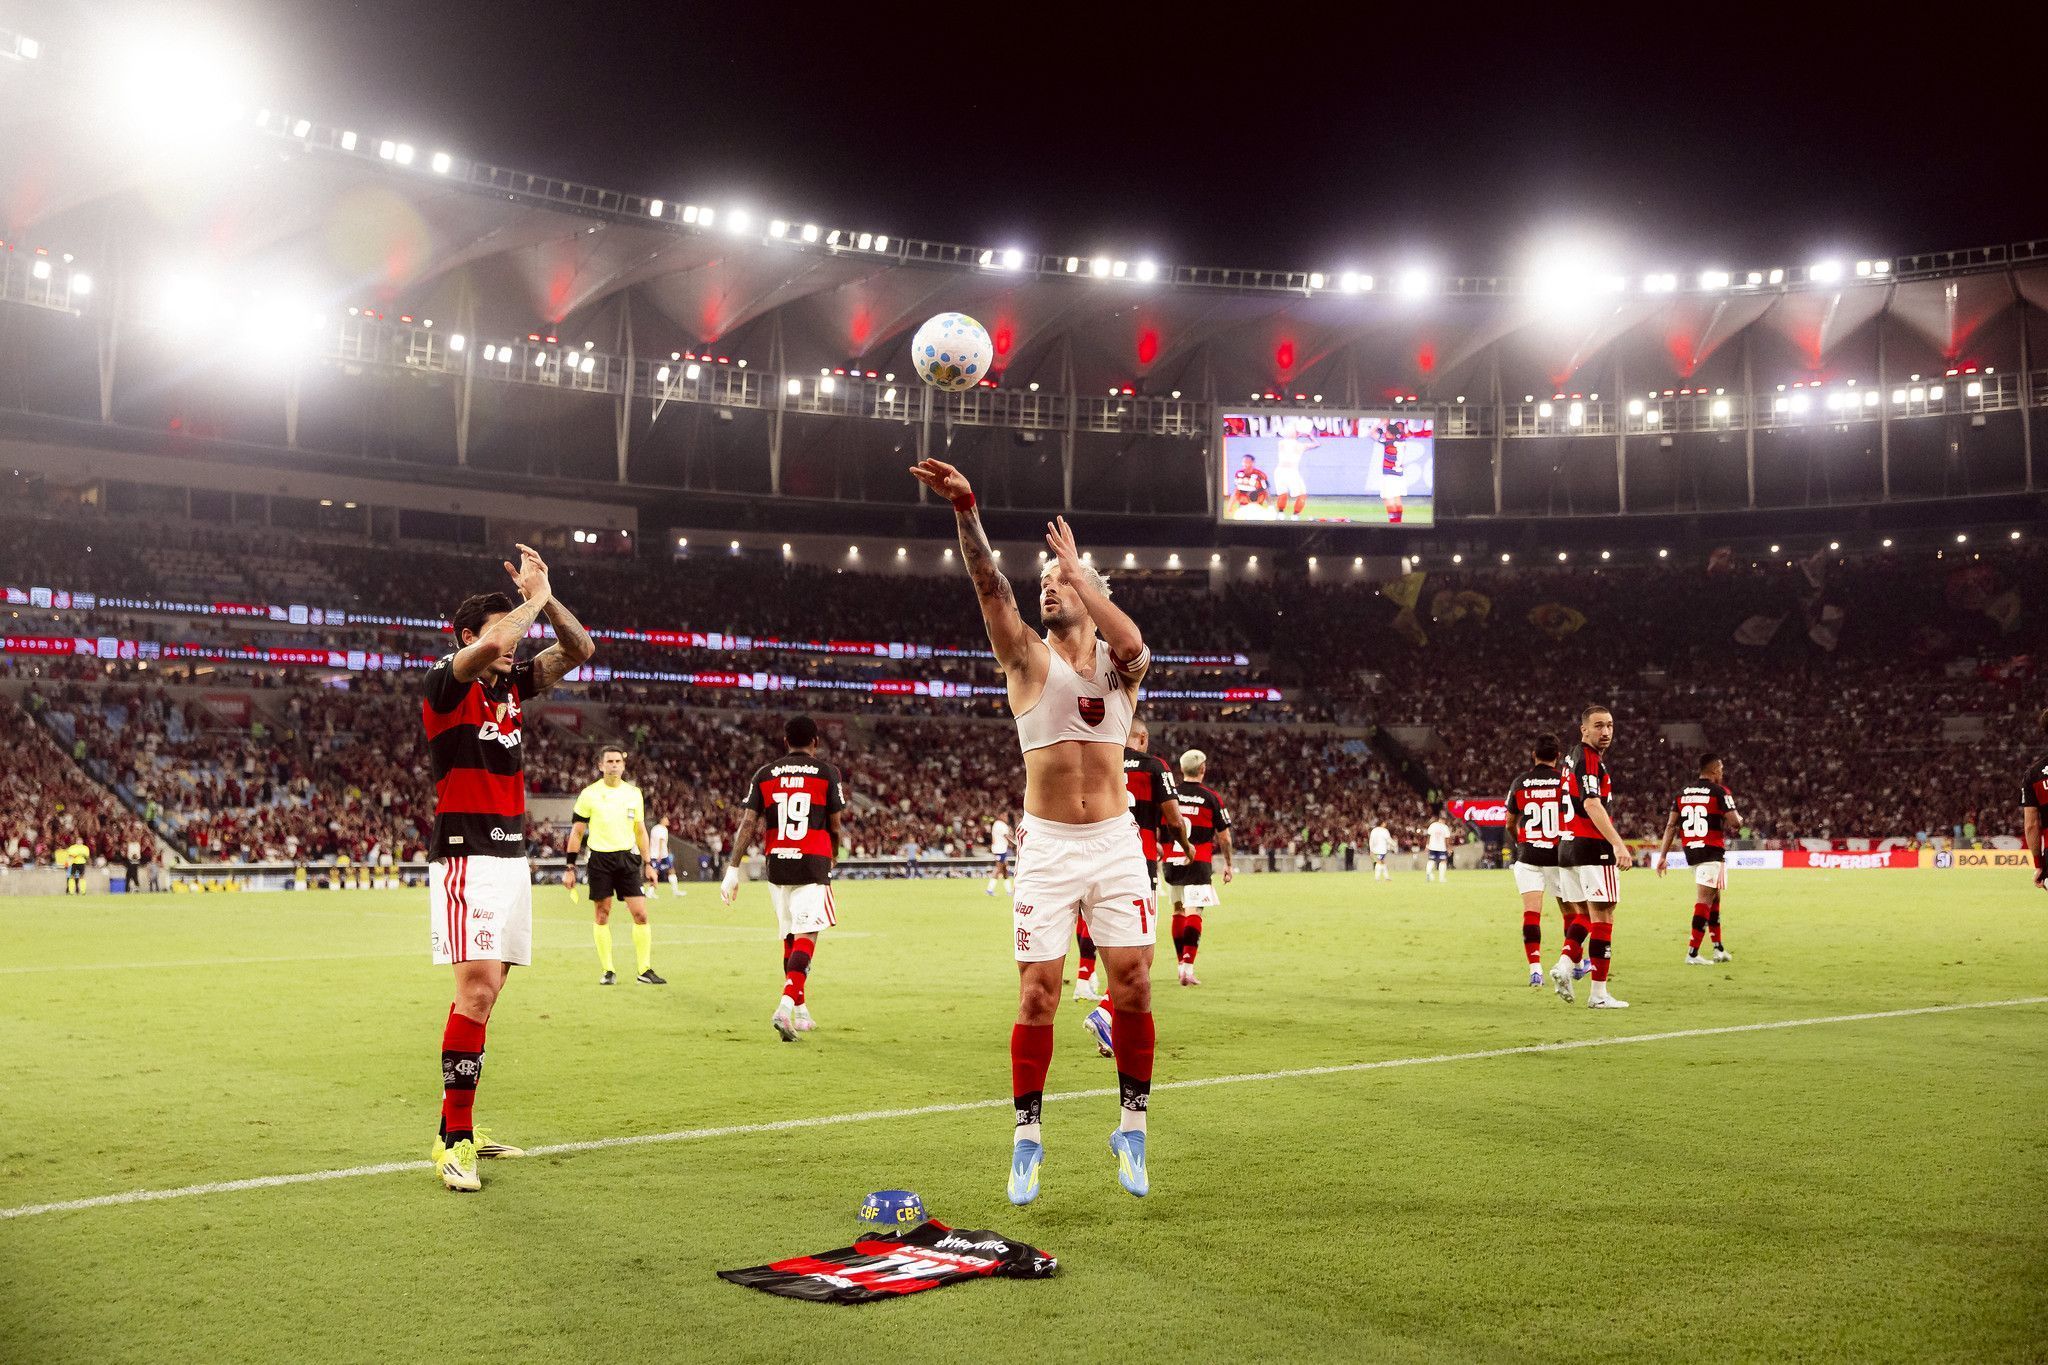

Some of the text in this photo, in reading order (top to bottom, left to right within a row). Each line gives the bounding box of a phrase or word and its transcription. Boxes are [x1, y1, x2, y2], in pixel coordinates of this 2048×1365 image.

[1104, 670, 1119, 692] 10
[772, 791, 811, 840] 19
[1523, 801, 1559, 839] 20
[1681, 804, 1708, 838] 26
[1808, 852, 1892, 868] SUPERBET
[1959, 855, 1988, 866] BOA
[472, 908, 495, 920] Wap
[1015, 901, 1034, 917] Wap
[860, 1205, 880, 1220] CBF
